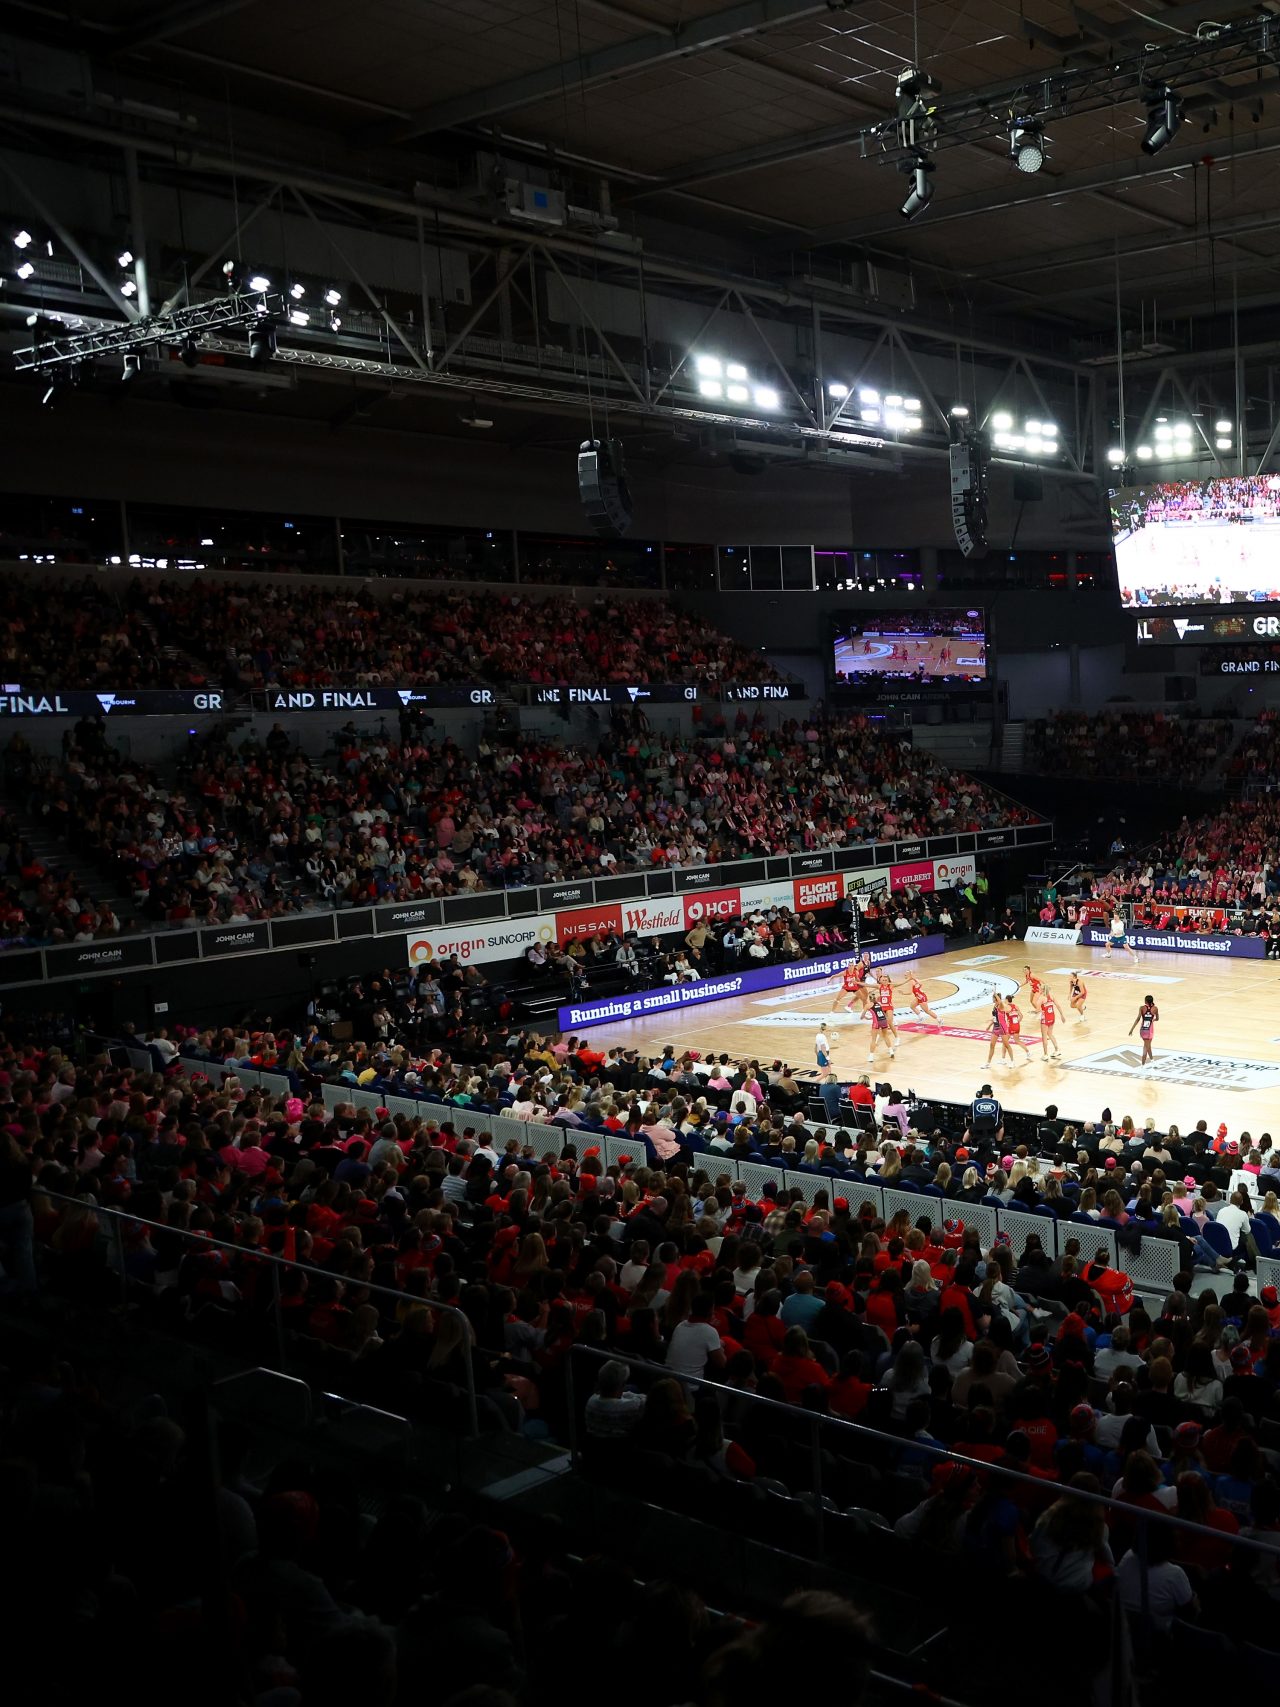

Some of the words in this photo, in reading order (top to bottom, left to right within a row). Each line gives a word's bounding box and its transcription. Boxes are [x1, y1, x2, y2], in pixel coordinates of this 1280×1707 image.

[1221, 661, 1260, 672] GRAND
[274, 693, 315, 708] AND
[322, 692, 377, 707] FINAL
[569, 688, 611, 702] FINAL
[0, 695, 69, 713] FINAL
[950, 864, 973, 877] origin
[902, 872, 932, 884] GILBERT
[799, 881, 837, 895] FLIGHT
[741, 899, 762, 907] SUNCORP
[799, 892, 838, 906] CENTRE
[705, 900, 737, 917] HCF
[392, 912, 408, 920] JOHN
[625, 908, 682, 931] Westfield
[563, 919, 617, 935] NISSAN
[215, 935, 235, 943] JOHN
[237, 932, 255, 940] CAIN
[1030, 930, 1074, 941] NISSAN
[1137, 935, 1144, 945] a
[1145, 934, 1176, 948] small
[1177, 937, 1231, 951] business?
[437, 937, 485, 959] origin
[488, 931, 536, 947] SUNCORP
[78, 952, 100, 961] JOHN
[102, 949, 122, 958] CAIN
[783, 961, 831, 980] Running
[832, 960, 840, 970] a
[870, 942, 918, 963] business?
[570, 1003, 631, 1024] Running
[633, 1000, 642, 1011] a
[643, 989, 681, 1009] small
[681, 977, 742, 1001] business?
[1158, 1061, 1239, 1074] SUPER
[1172, 1055, 1280, 1072] SUNCORP
